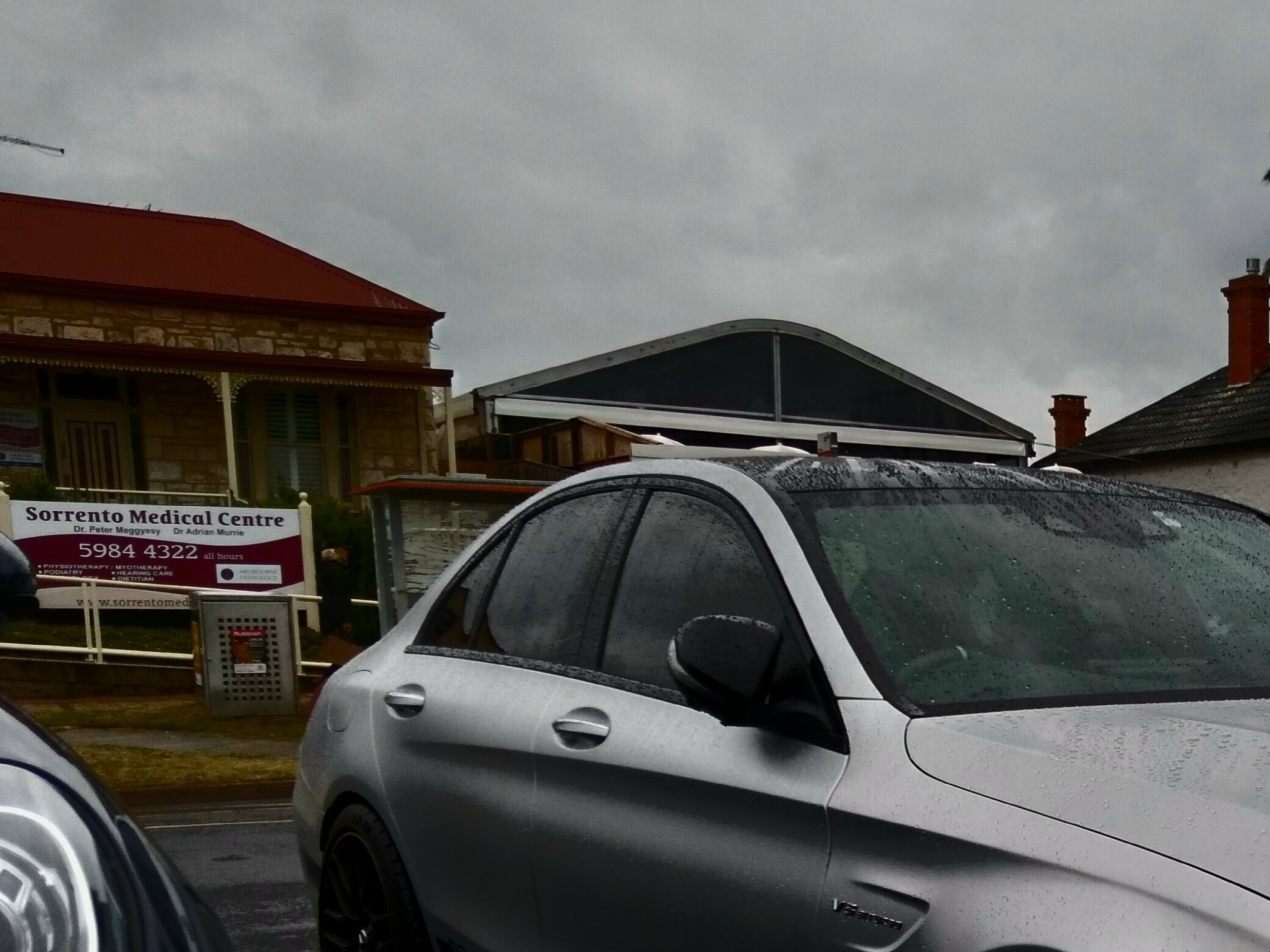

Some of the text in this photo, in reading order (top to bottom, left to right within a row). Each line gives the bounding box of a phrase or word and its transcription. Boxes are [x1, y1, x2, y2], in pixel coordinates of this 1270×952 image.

[26, 506, 285, 527] Sorrento Medical Centre
[116, 526, 161, 536] Meggyesy
[186, 528, 214, 536] Adrian
[217, 529, 244, 537] Murrie
[79, 543, 136, 559] 5984
[143, 544, 198, 560] 4322
[203, 552, 215, 560] all
[76, 598, 190, 607] ww.sorrentomed
[833, 898, 859, 917] V8
